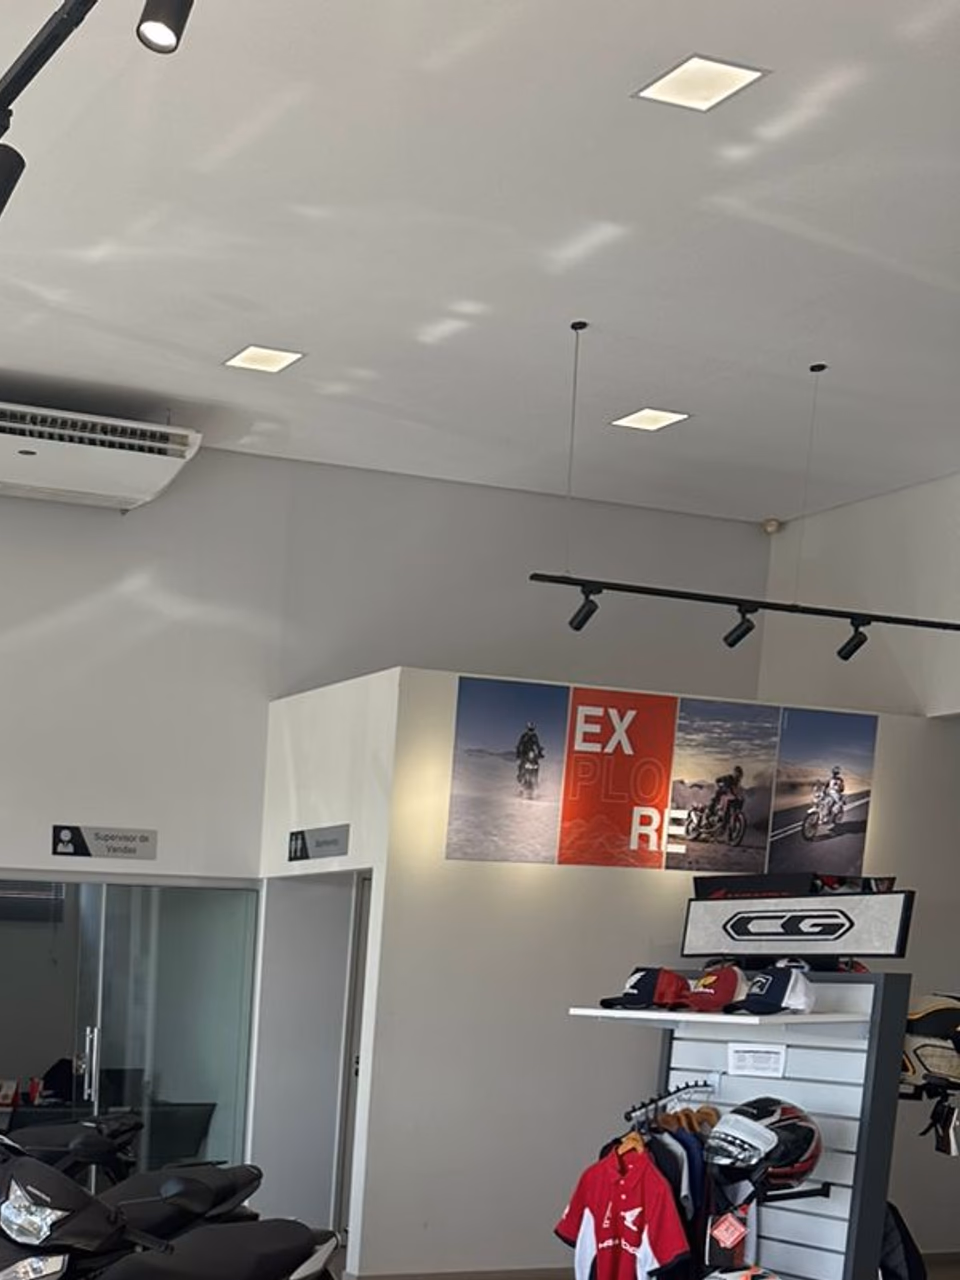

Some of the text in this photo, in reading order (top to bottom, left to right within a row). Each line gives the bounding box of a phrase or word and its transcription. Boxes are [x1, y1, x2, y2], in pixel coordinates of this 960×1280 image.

[573, 705, 637, 755] EX
[569, 755, 666, 804] PLO
[628, 805, 688, 853] RE
[729, 913, 846, 937] CG
